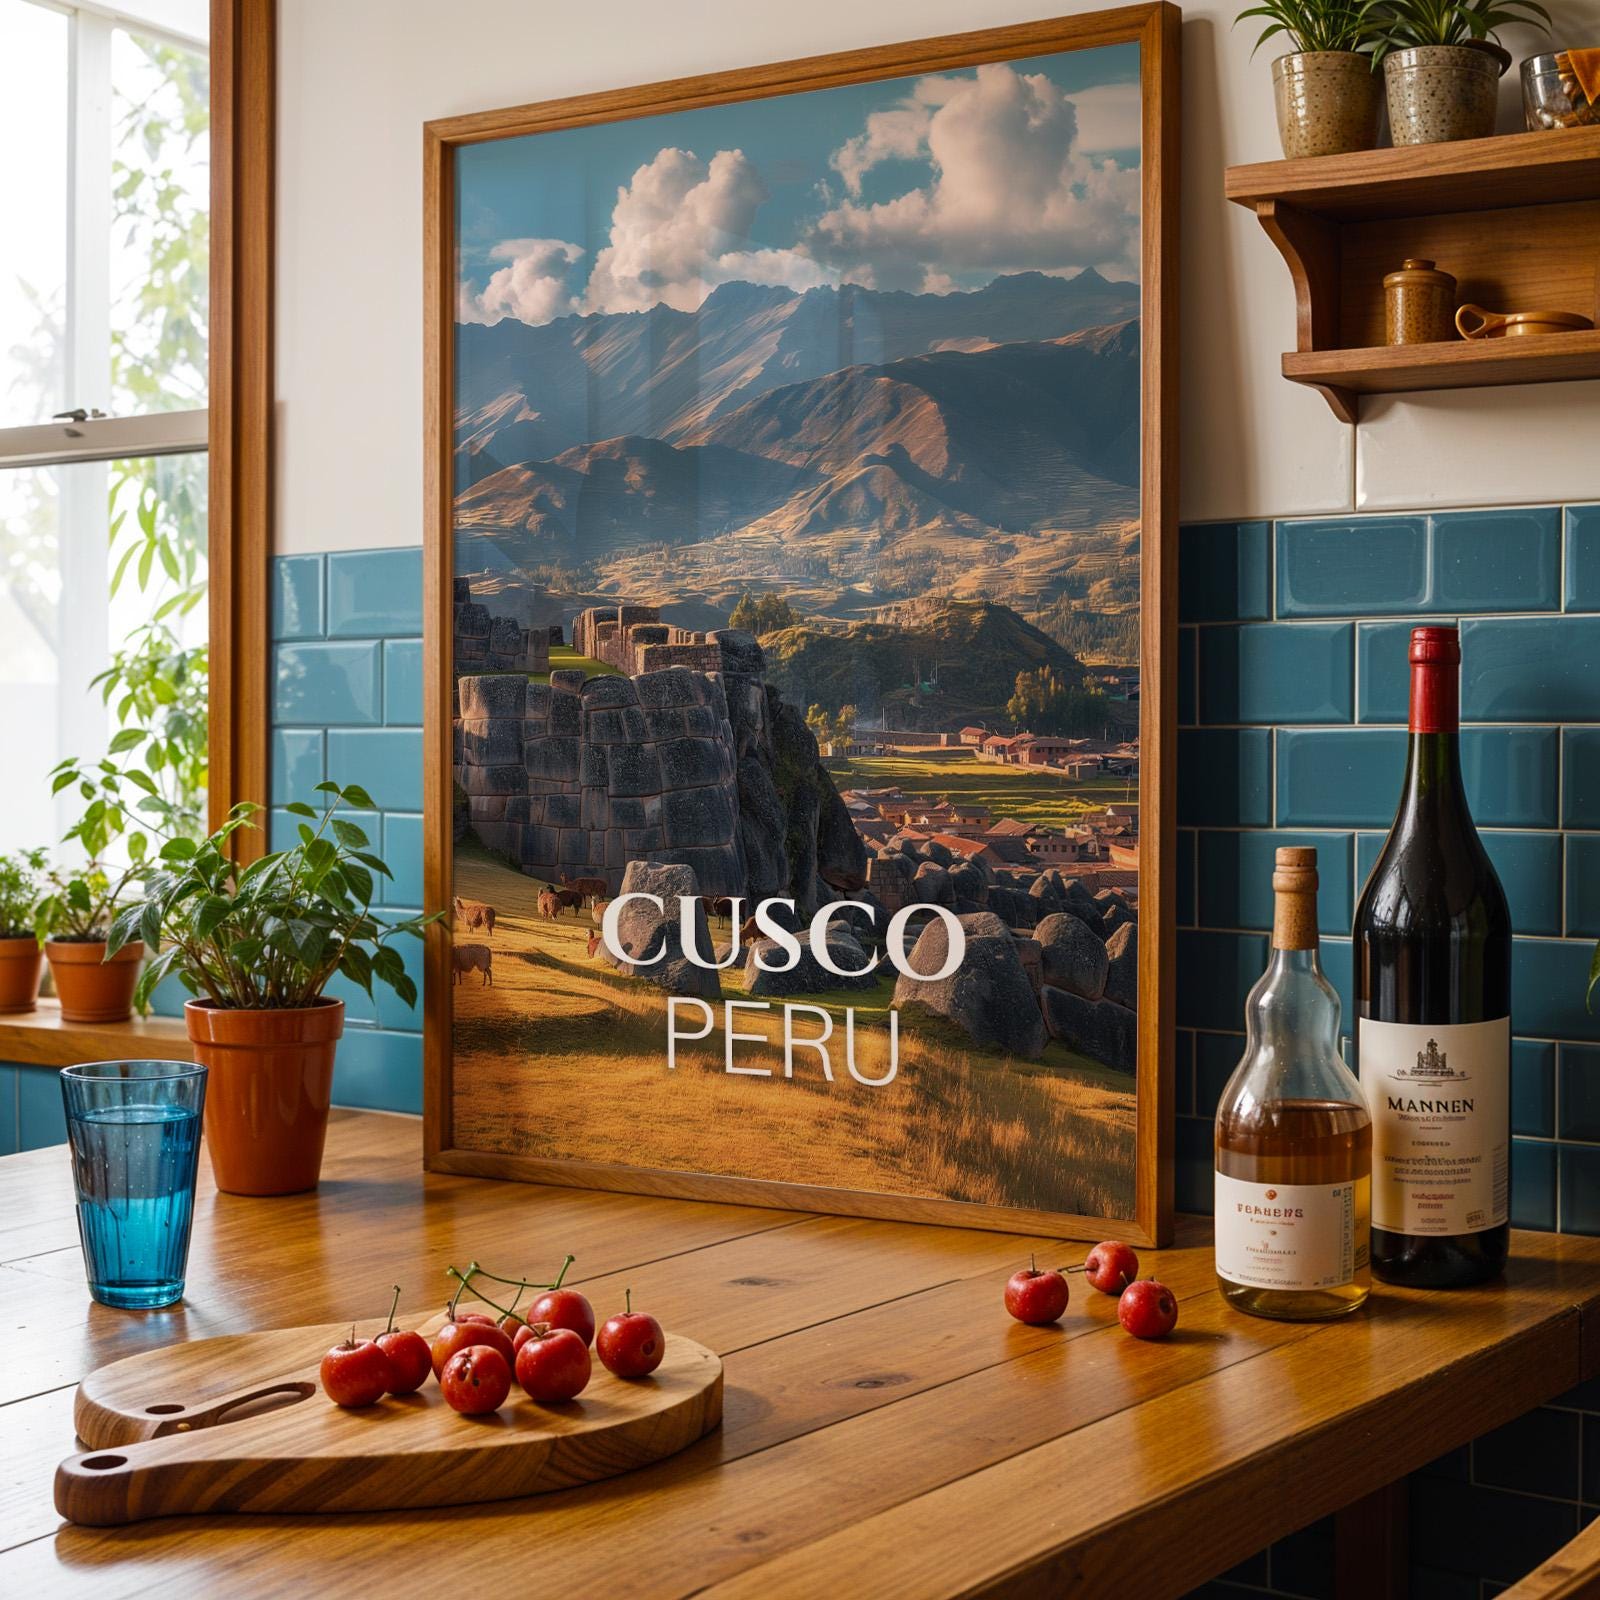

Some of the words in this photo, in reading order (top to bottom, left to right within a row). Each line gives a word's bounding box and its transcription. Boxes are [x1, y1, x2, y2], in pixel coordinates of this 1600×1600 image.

[602, 892, 966, 981] CUSCO
[667, 996, 898, 1086] PERU
[1388, 1096, 1474, 1113] MANNEN
